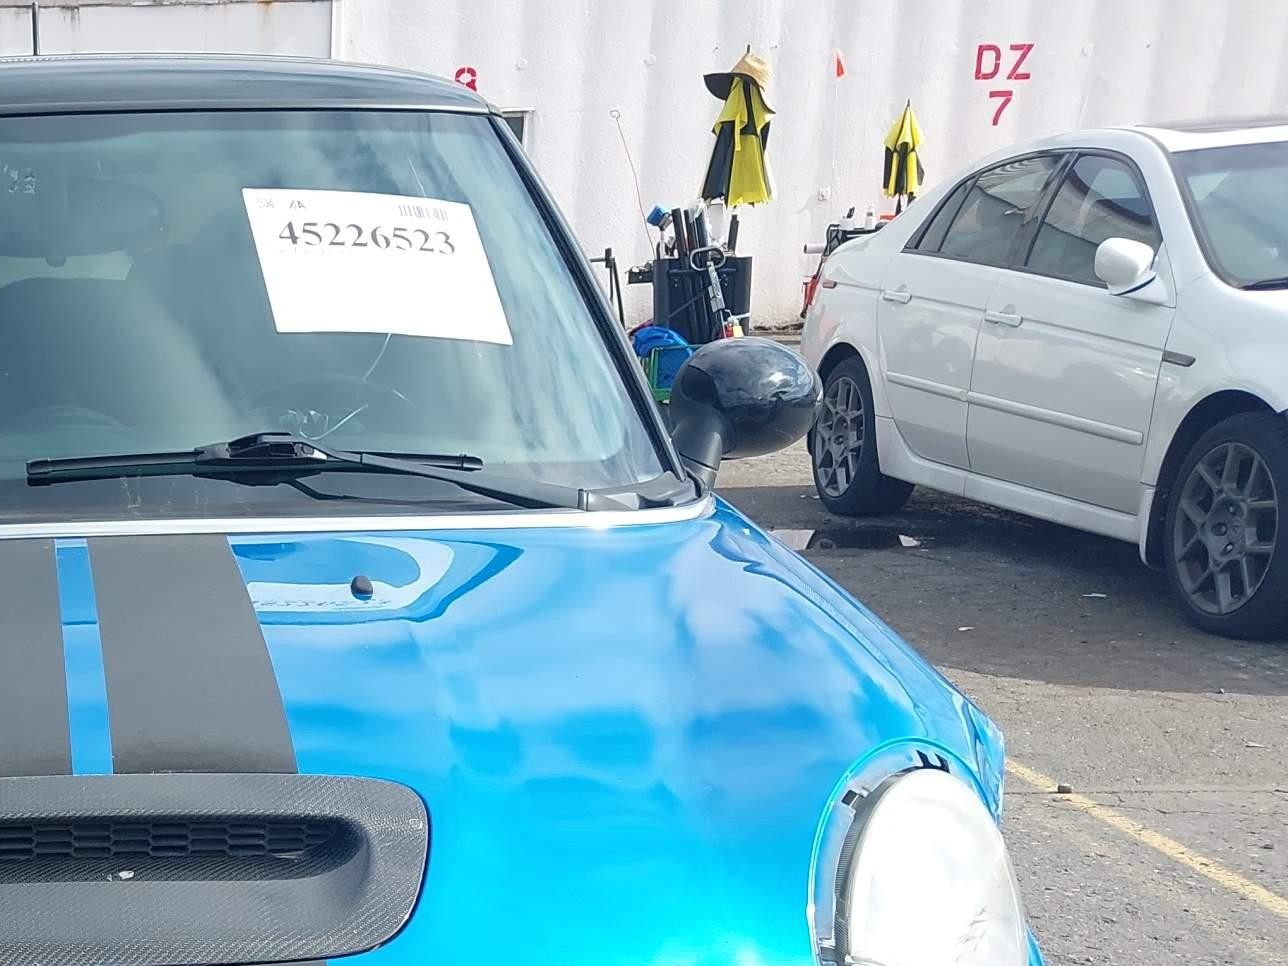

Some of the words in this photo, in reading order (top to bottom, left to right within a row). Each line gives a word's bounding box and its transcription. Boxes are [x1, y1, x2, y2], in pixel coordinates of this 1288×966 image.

[974, 43, 1034, 80] DZ
[989, 90, 1013, 126] 7
[279, 221, 455, 255] 45226523
